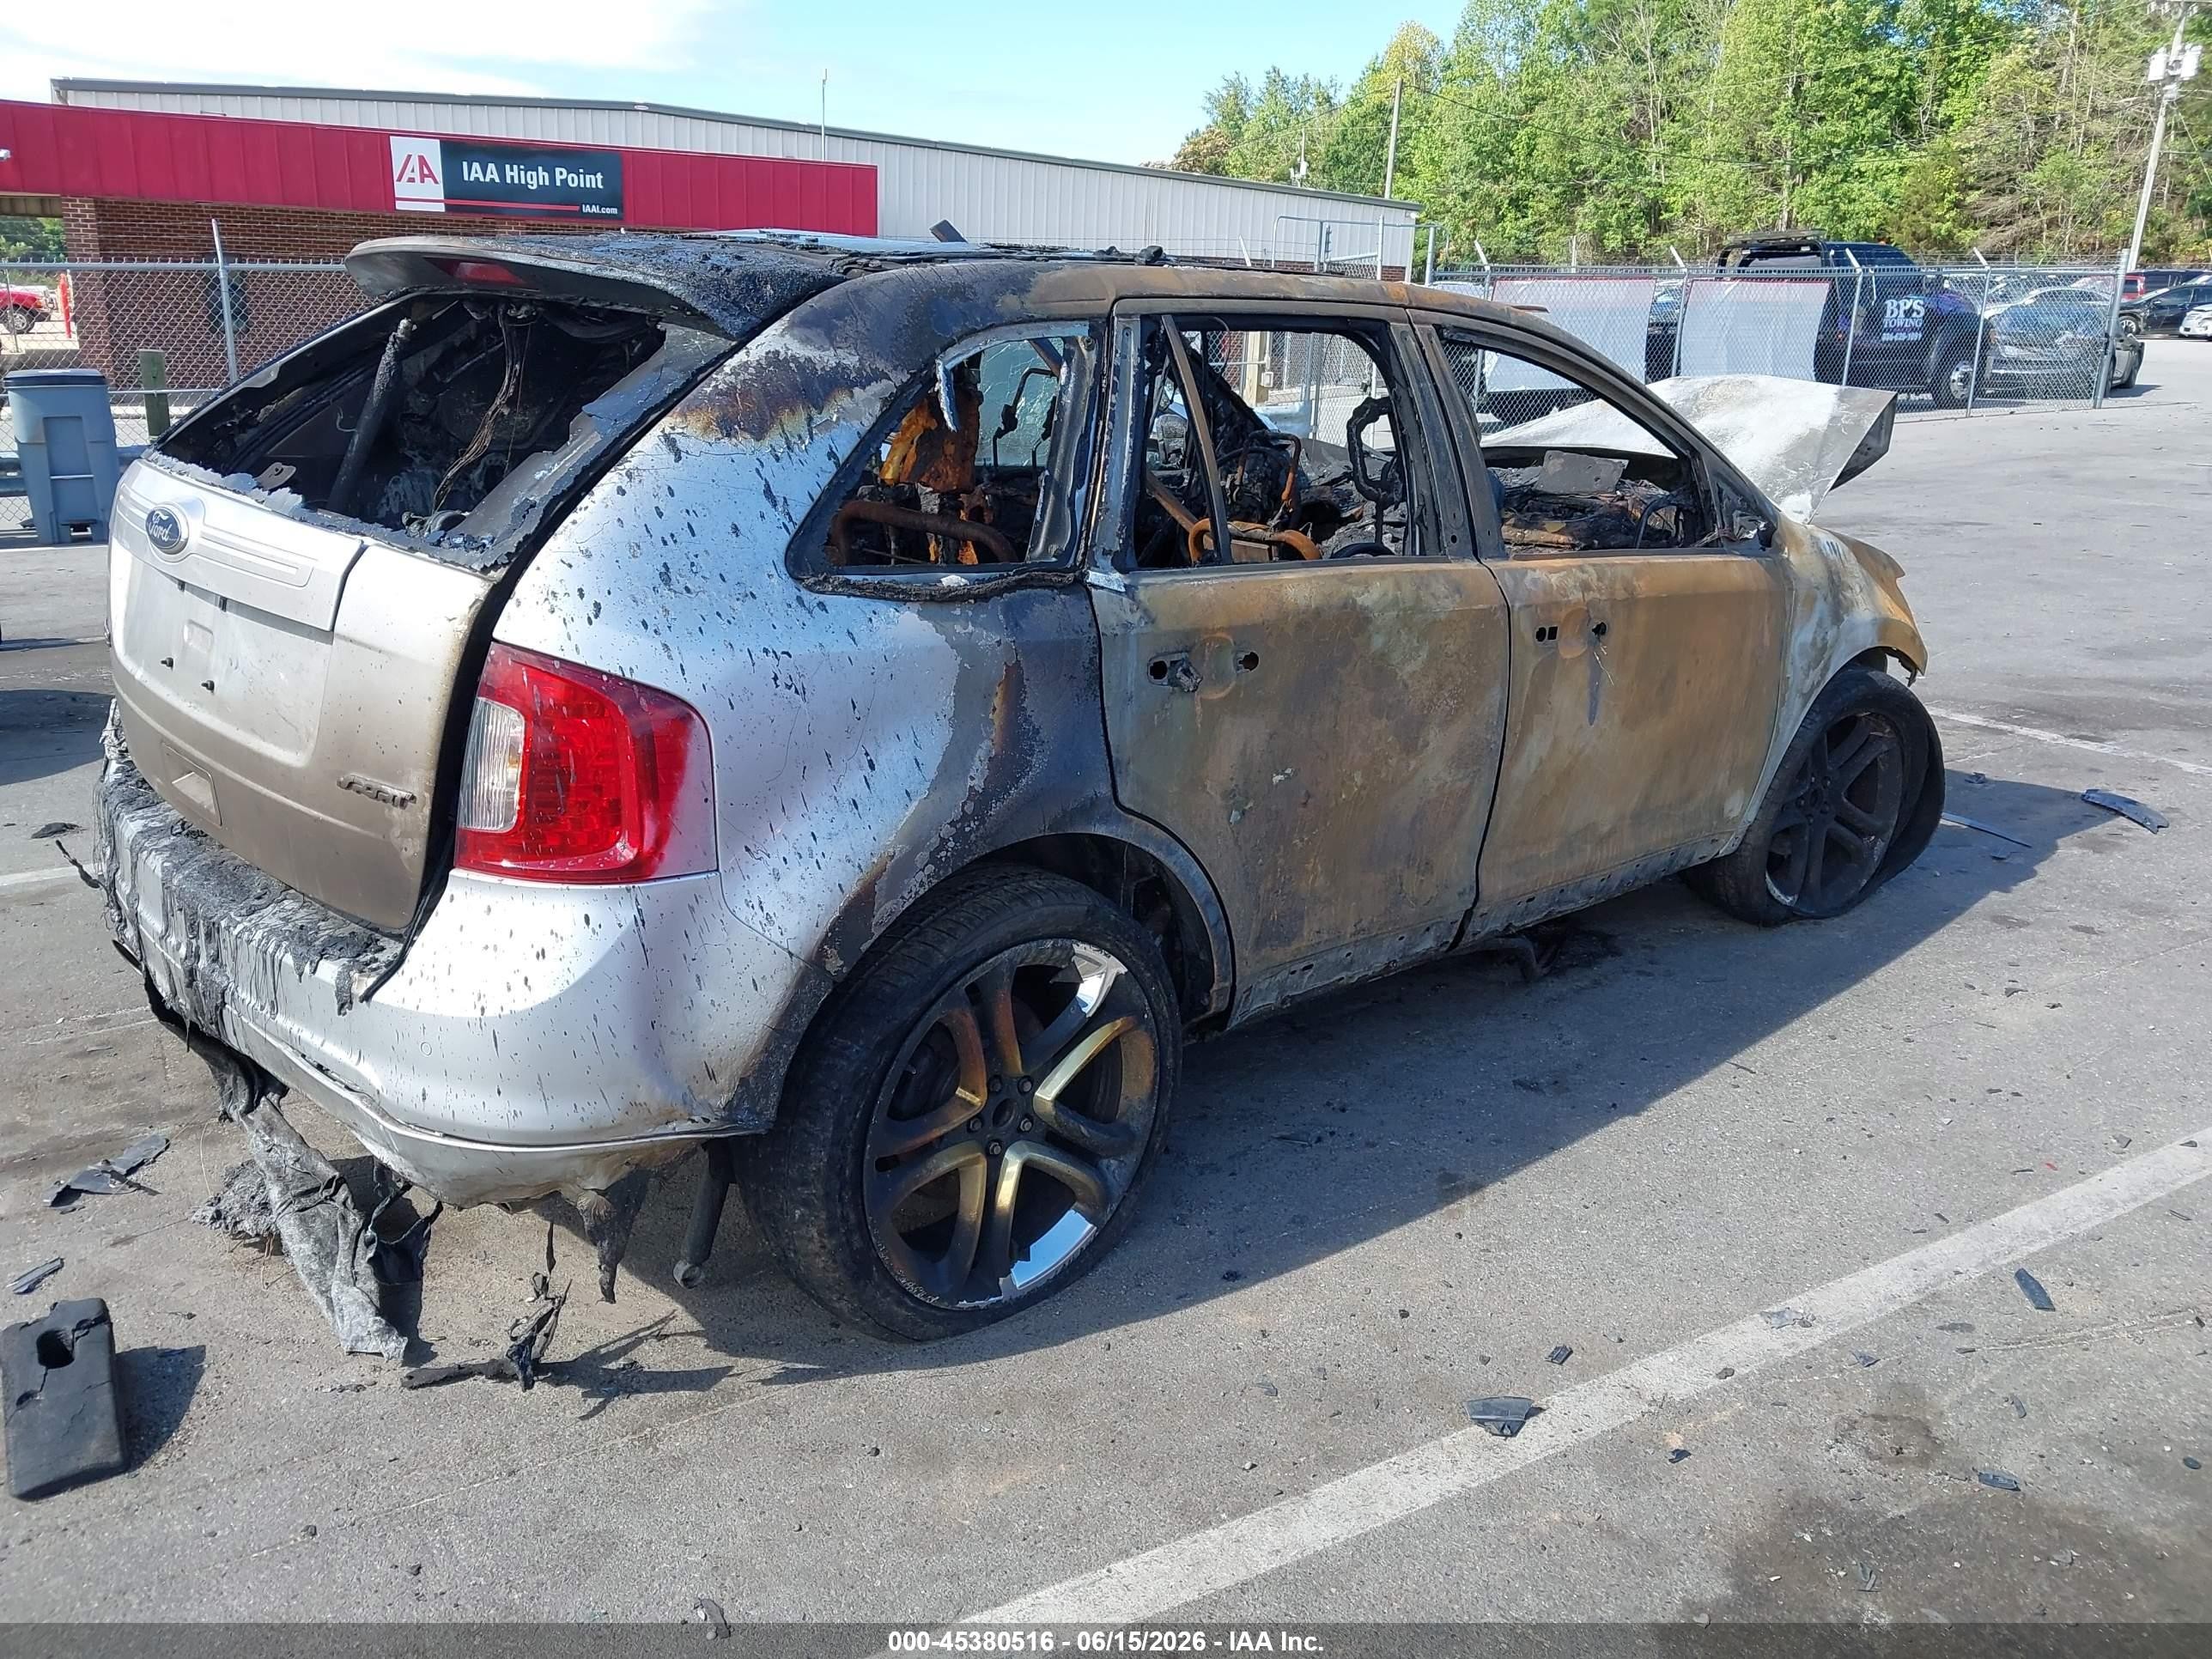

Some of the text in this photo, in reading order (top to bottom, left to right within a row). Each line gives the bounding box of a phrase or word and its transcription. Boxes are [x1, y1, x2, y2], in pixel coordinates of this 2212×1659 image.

[461, 161, 605, 191] IAA High Point
[581, 203, 618, 216] IAAI.com
[1882, 318, 1923, 329] TOWING
[148, 510, 173, 543] Ford
